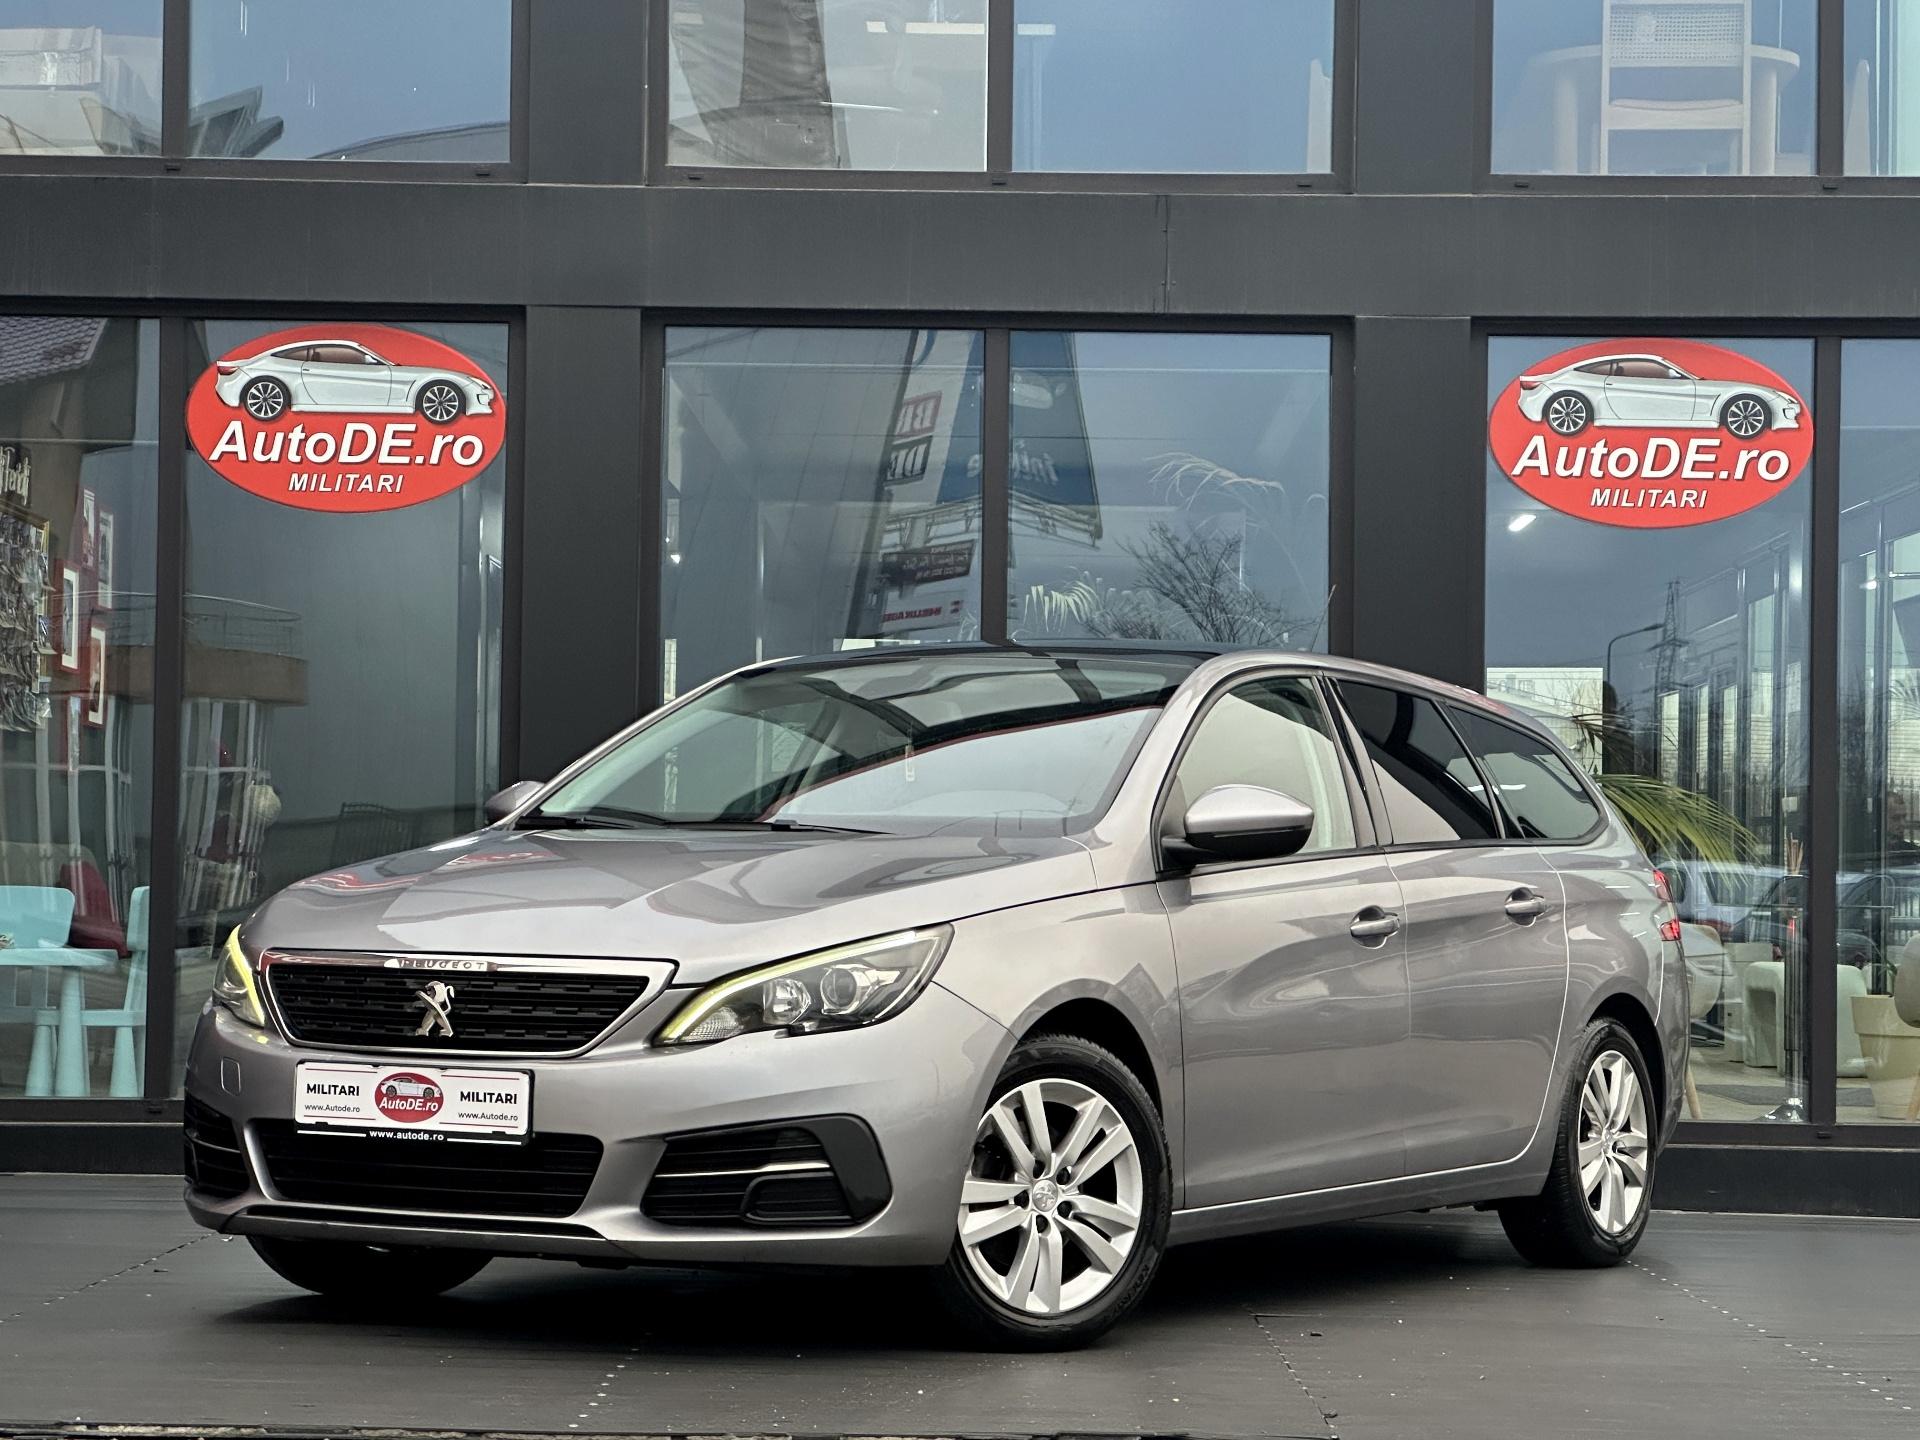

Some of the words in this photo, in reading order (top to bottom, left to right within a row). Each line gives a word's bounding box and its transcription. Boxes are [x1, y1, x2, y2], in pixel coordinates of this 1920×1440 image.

[208, 419, 484, 467] AutoDE.ro
[1511, 434, 1791, 482] AutoDE.ro
[288, 472, 404, 494] MILITARI
[1590, 488, 1708, 509] MILITARI
[306, 1083, 360, 1097] MILITARI
[379, 1096, 439, 1112] AutoDE.ro
[459, 1091, 518, 1105] MILITARI
[304, 1103, 361, 1114] www.Autode.ro
[457, 1111, 519, 1122] www.Autode.ro
[369, 1129, 445, 1142] www.autode.ro
